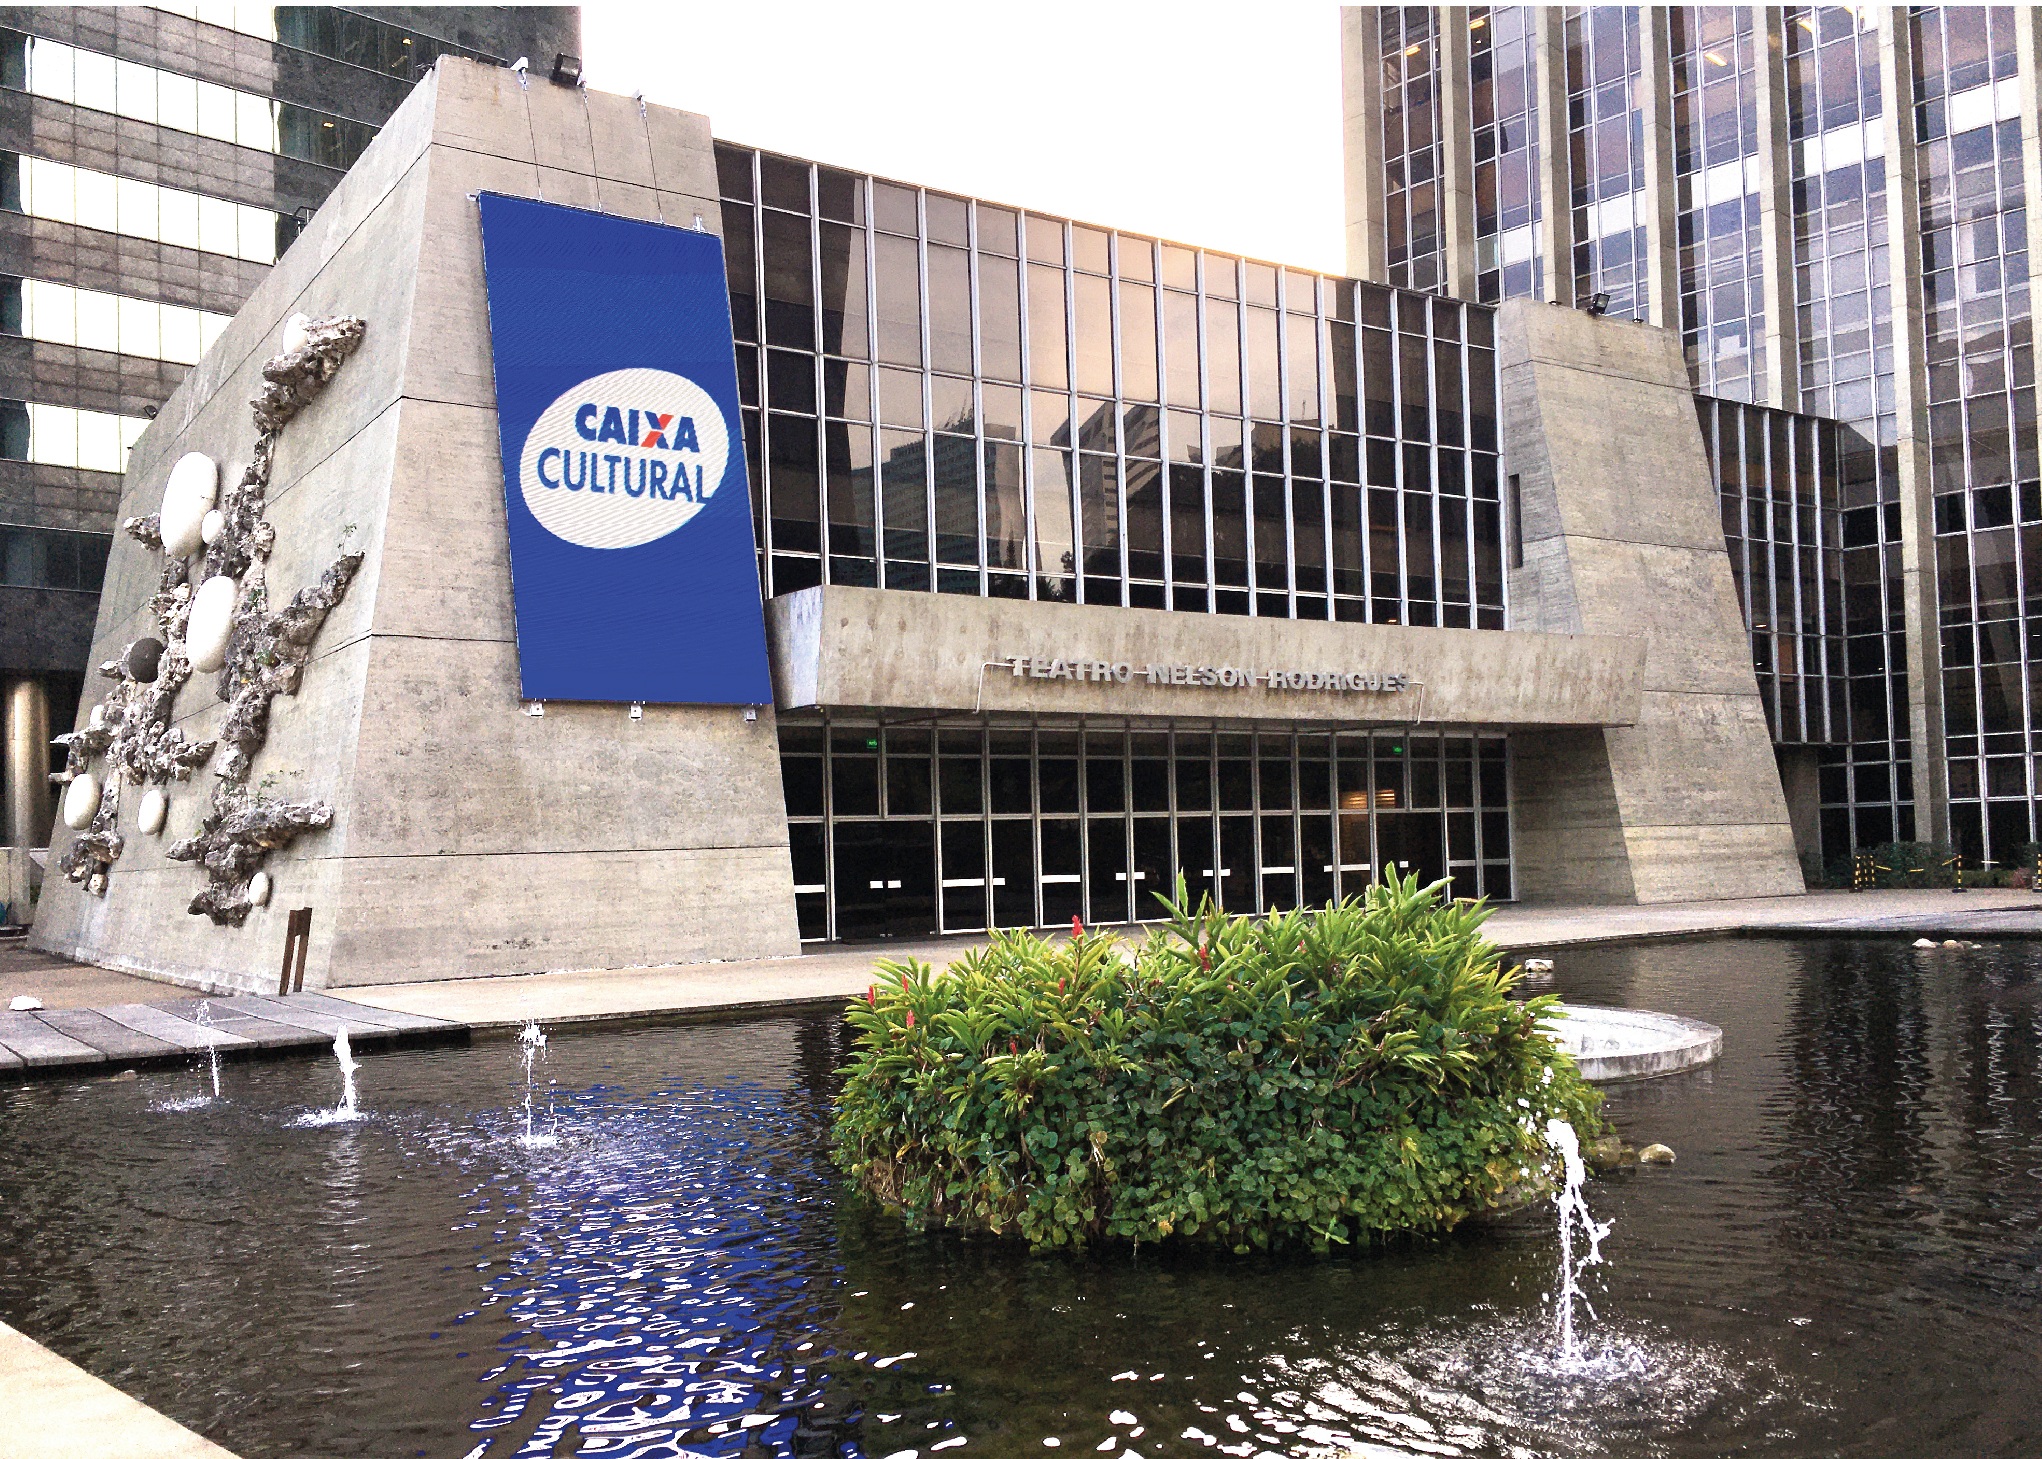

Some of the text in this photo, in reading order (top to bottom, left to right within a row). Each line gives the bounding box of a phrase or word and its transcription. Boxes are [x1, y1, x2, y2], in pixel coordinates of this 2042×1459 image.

[574, 403, 700, 453] CAIXA
[537, 447, 712, 503] CULTURAL
[1006, 655, 1410, 692] TEATRO NELSON RODRIGUES
